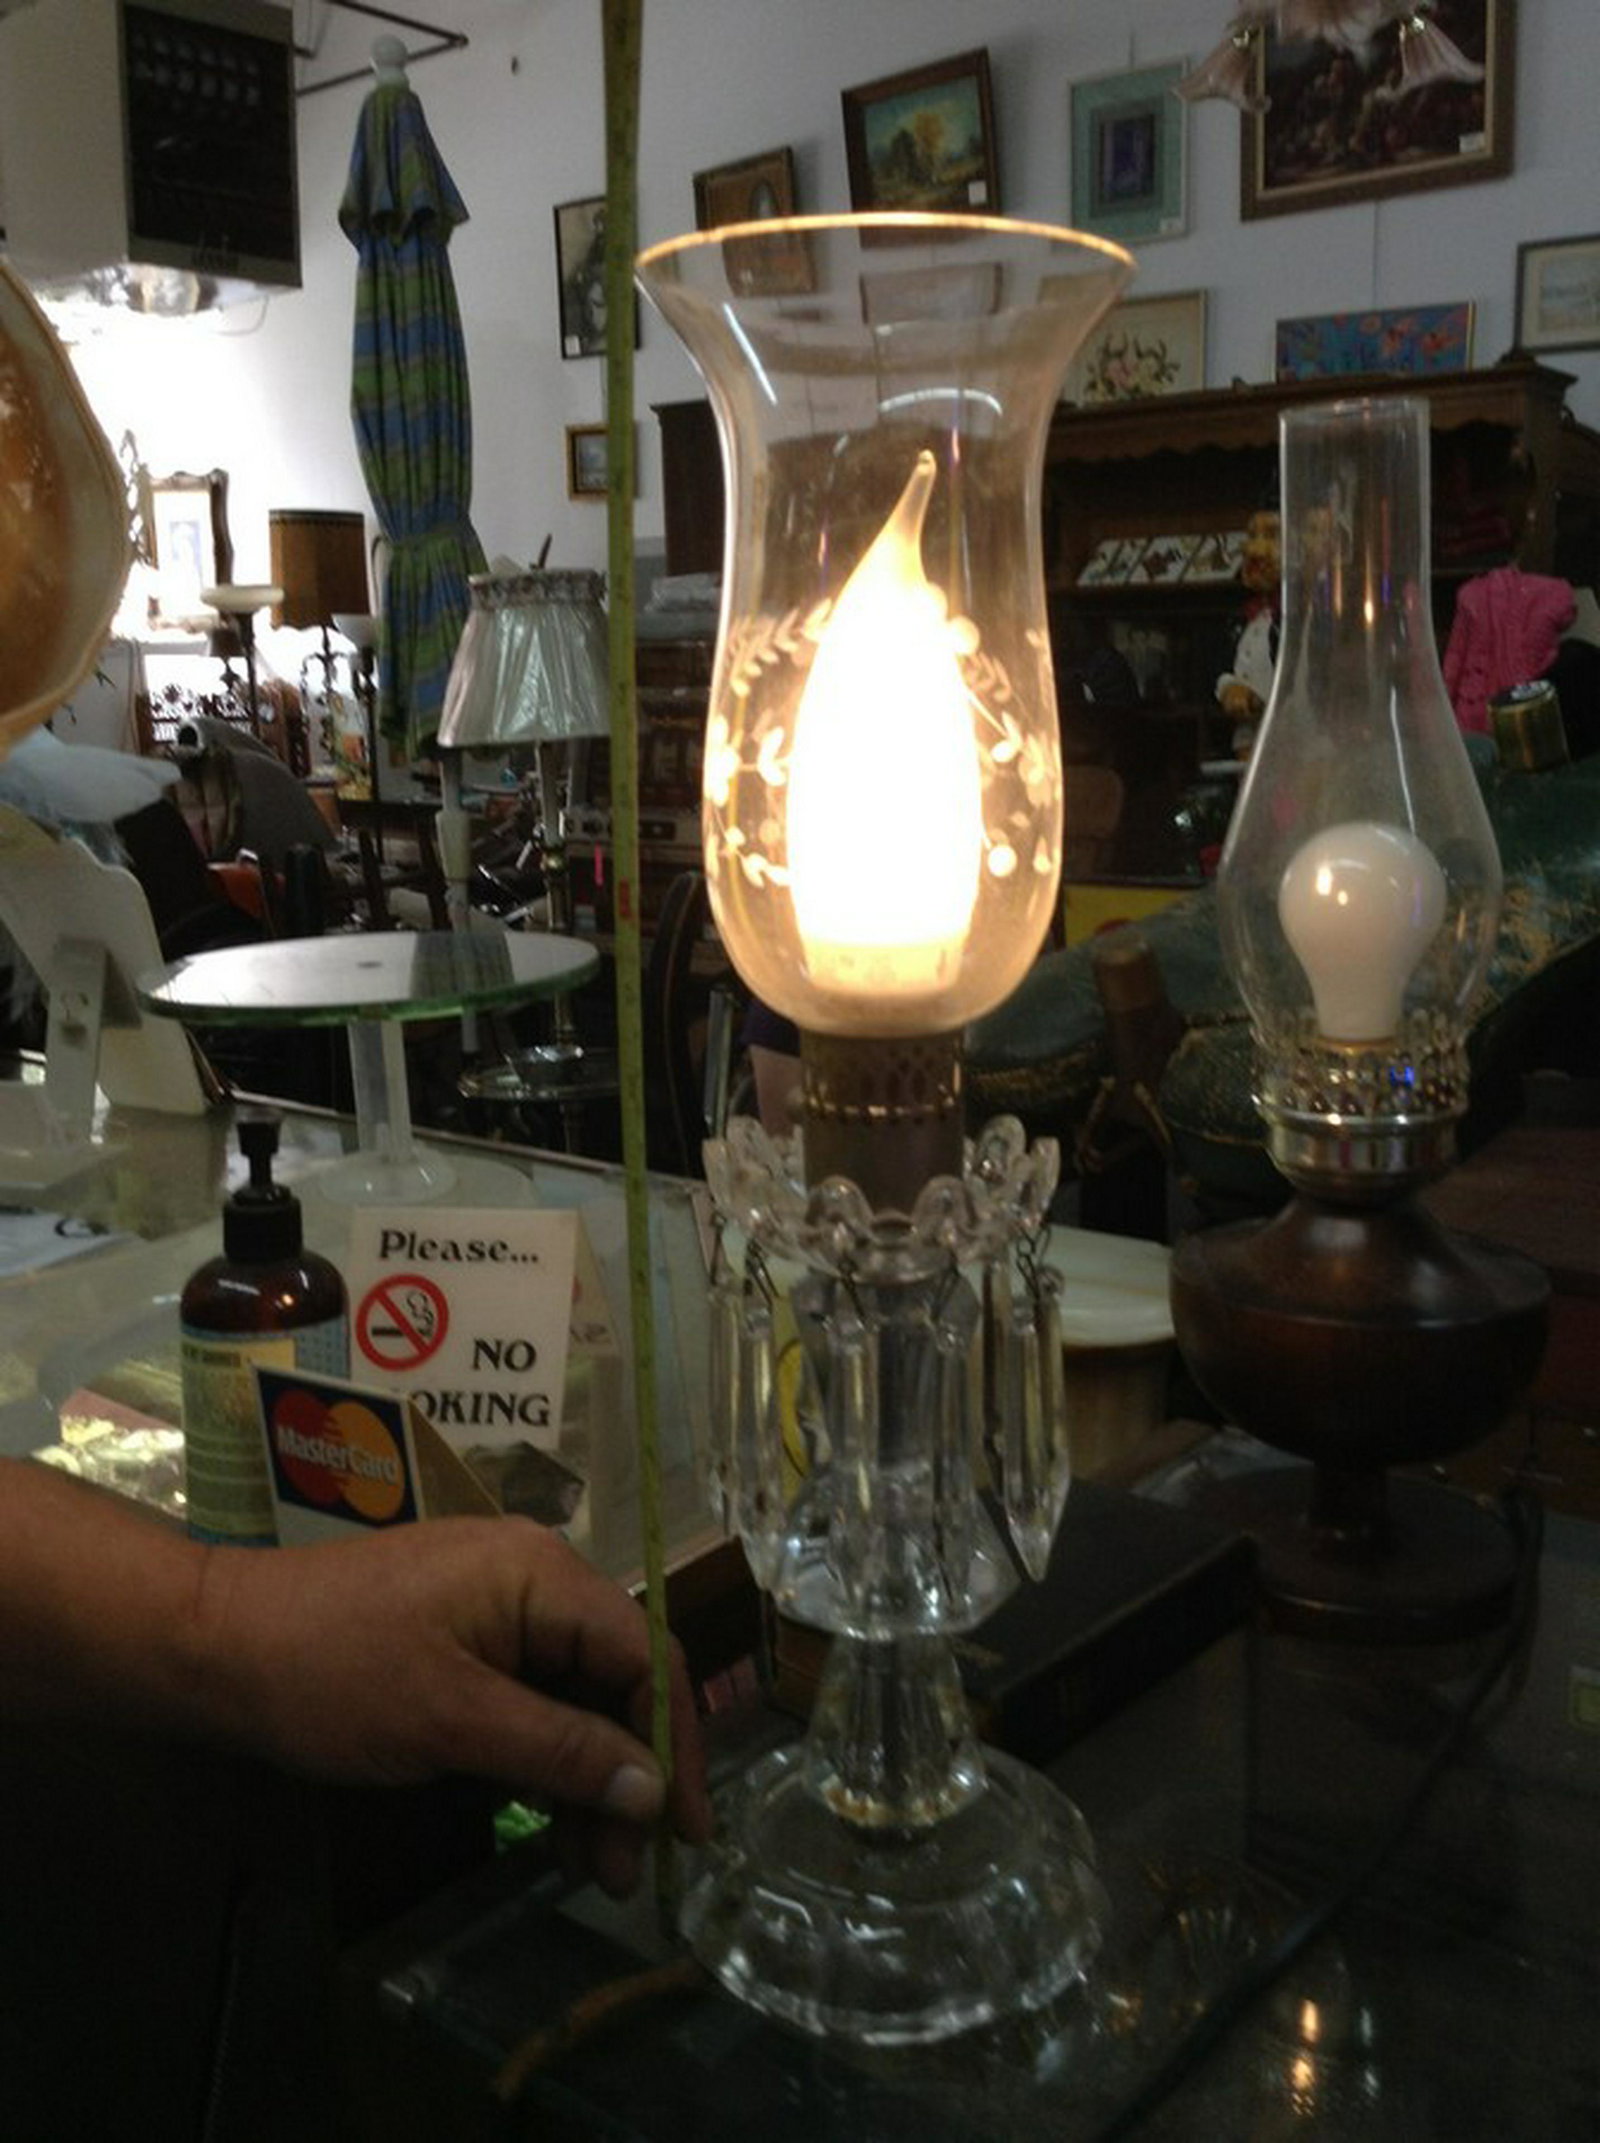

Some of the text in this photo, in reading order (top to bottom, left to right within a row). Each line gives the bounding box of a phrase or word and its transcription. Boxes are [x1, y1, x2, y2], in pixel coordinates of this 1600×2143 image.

[379, 1229, 538, 1262] Please...
[473, 1338, 537, 1373] NO
[411, 1390, 549, 1426] OKING
[277, 1425, 397, 1485] MasterCard
